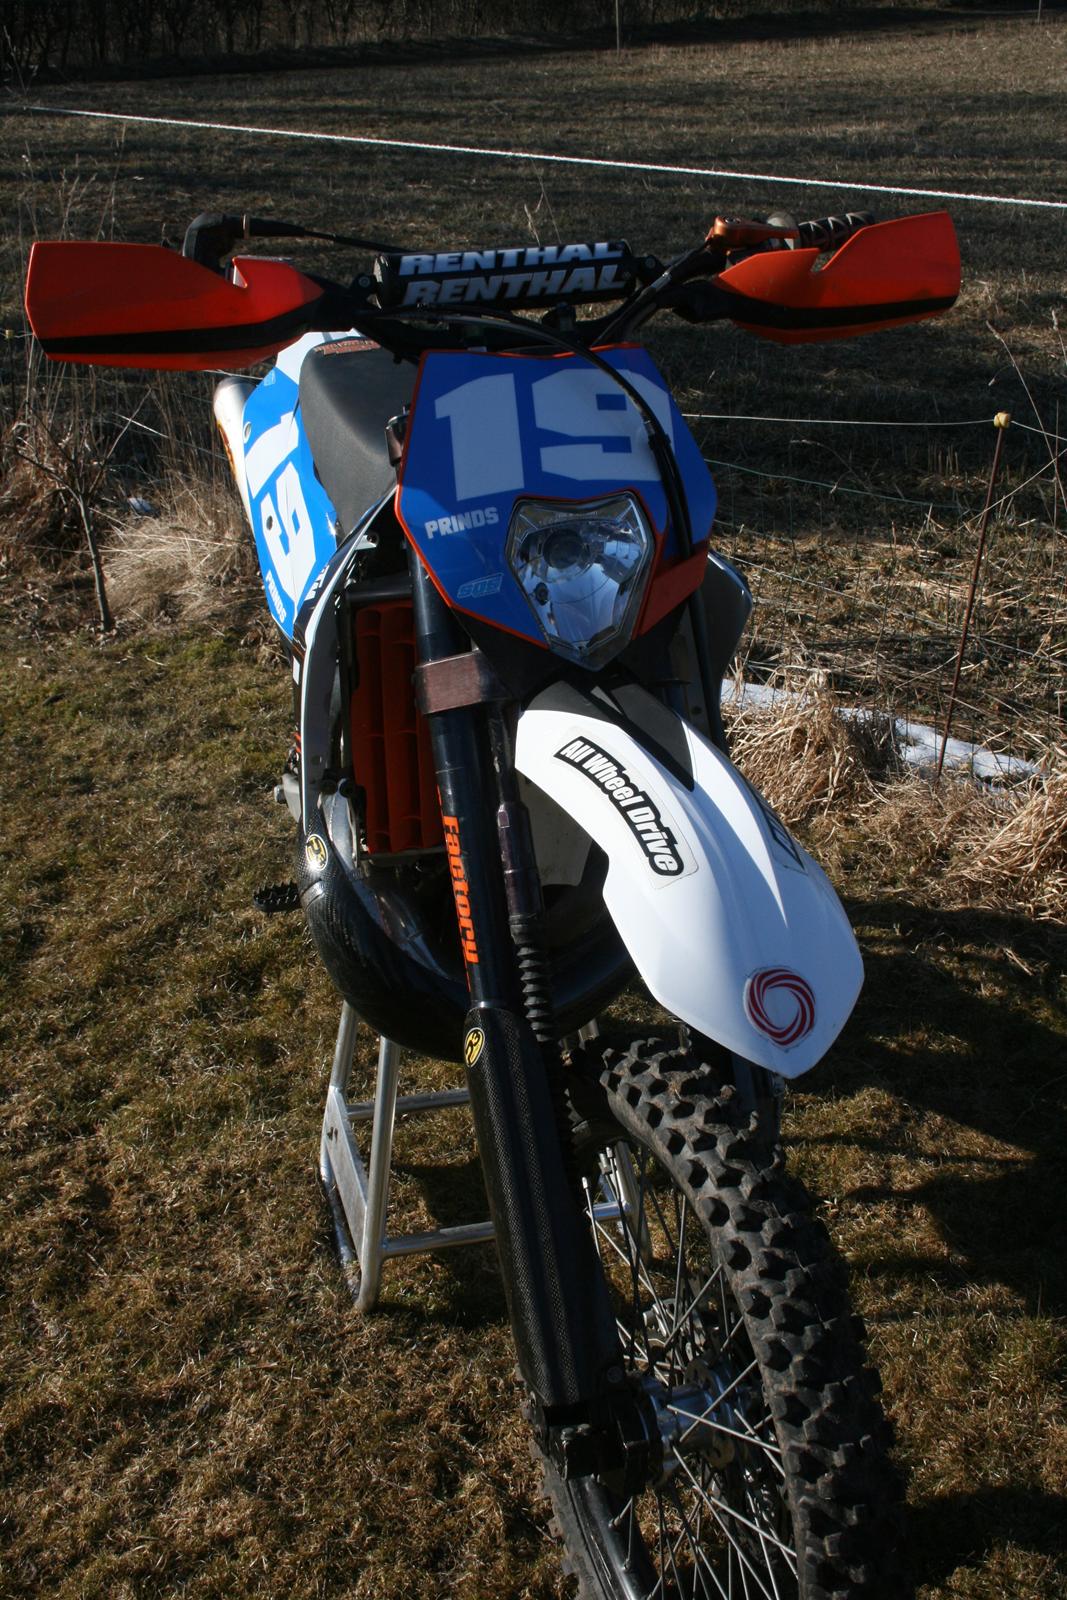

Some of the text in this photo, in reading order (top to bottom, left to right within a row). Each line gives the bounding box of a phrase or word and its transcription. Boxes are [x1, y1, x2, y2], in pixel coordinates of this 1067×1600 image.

[400, 242, 624, 276] RENTHAL
[403, 264, 626, 306] RENTHAL
[434, 369, 675, 501] 19
[424, 507, 499, 539] PRINDS
[559, 740, 679, 871] All Wheel Drive
